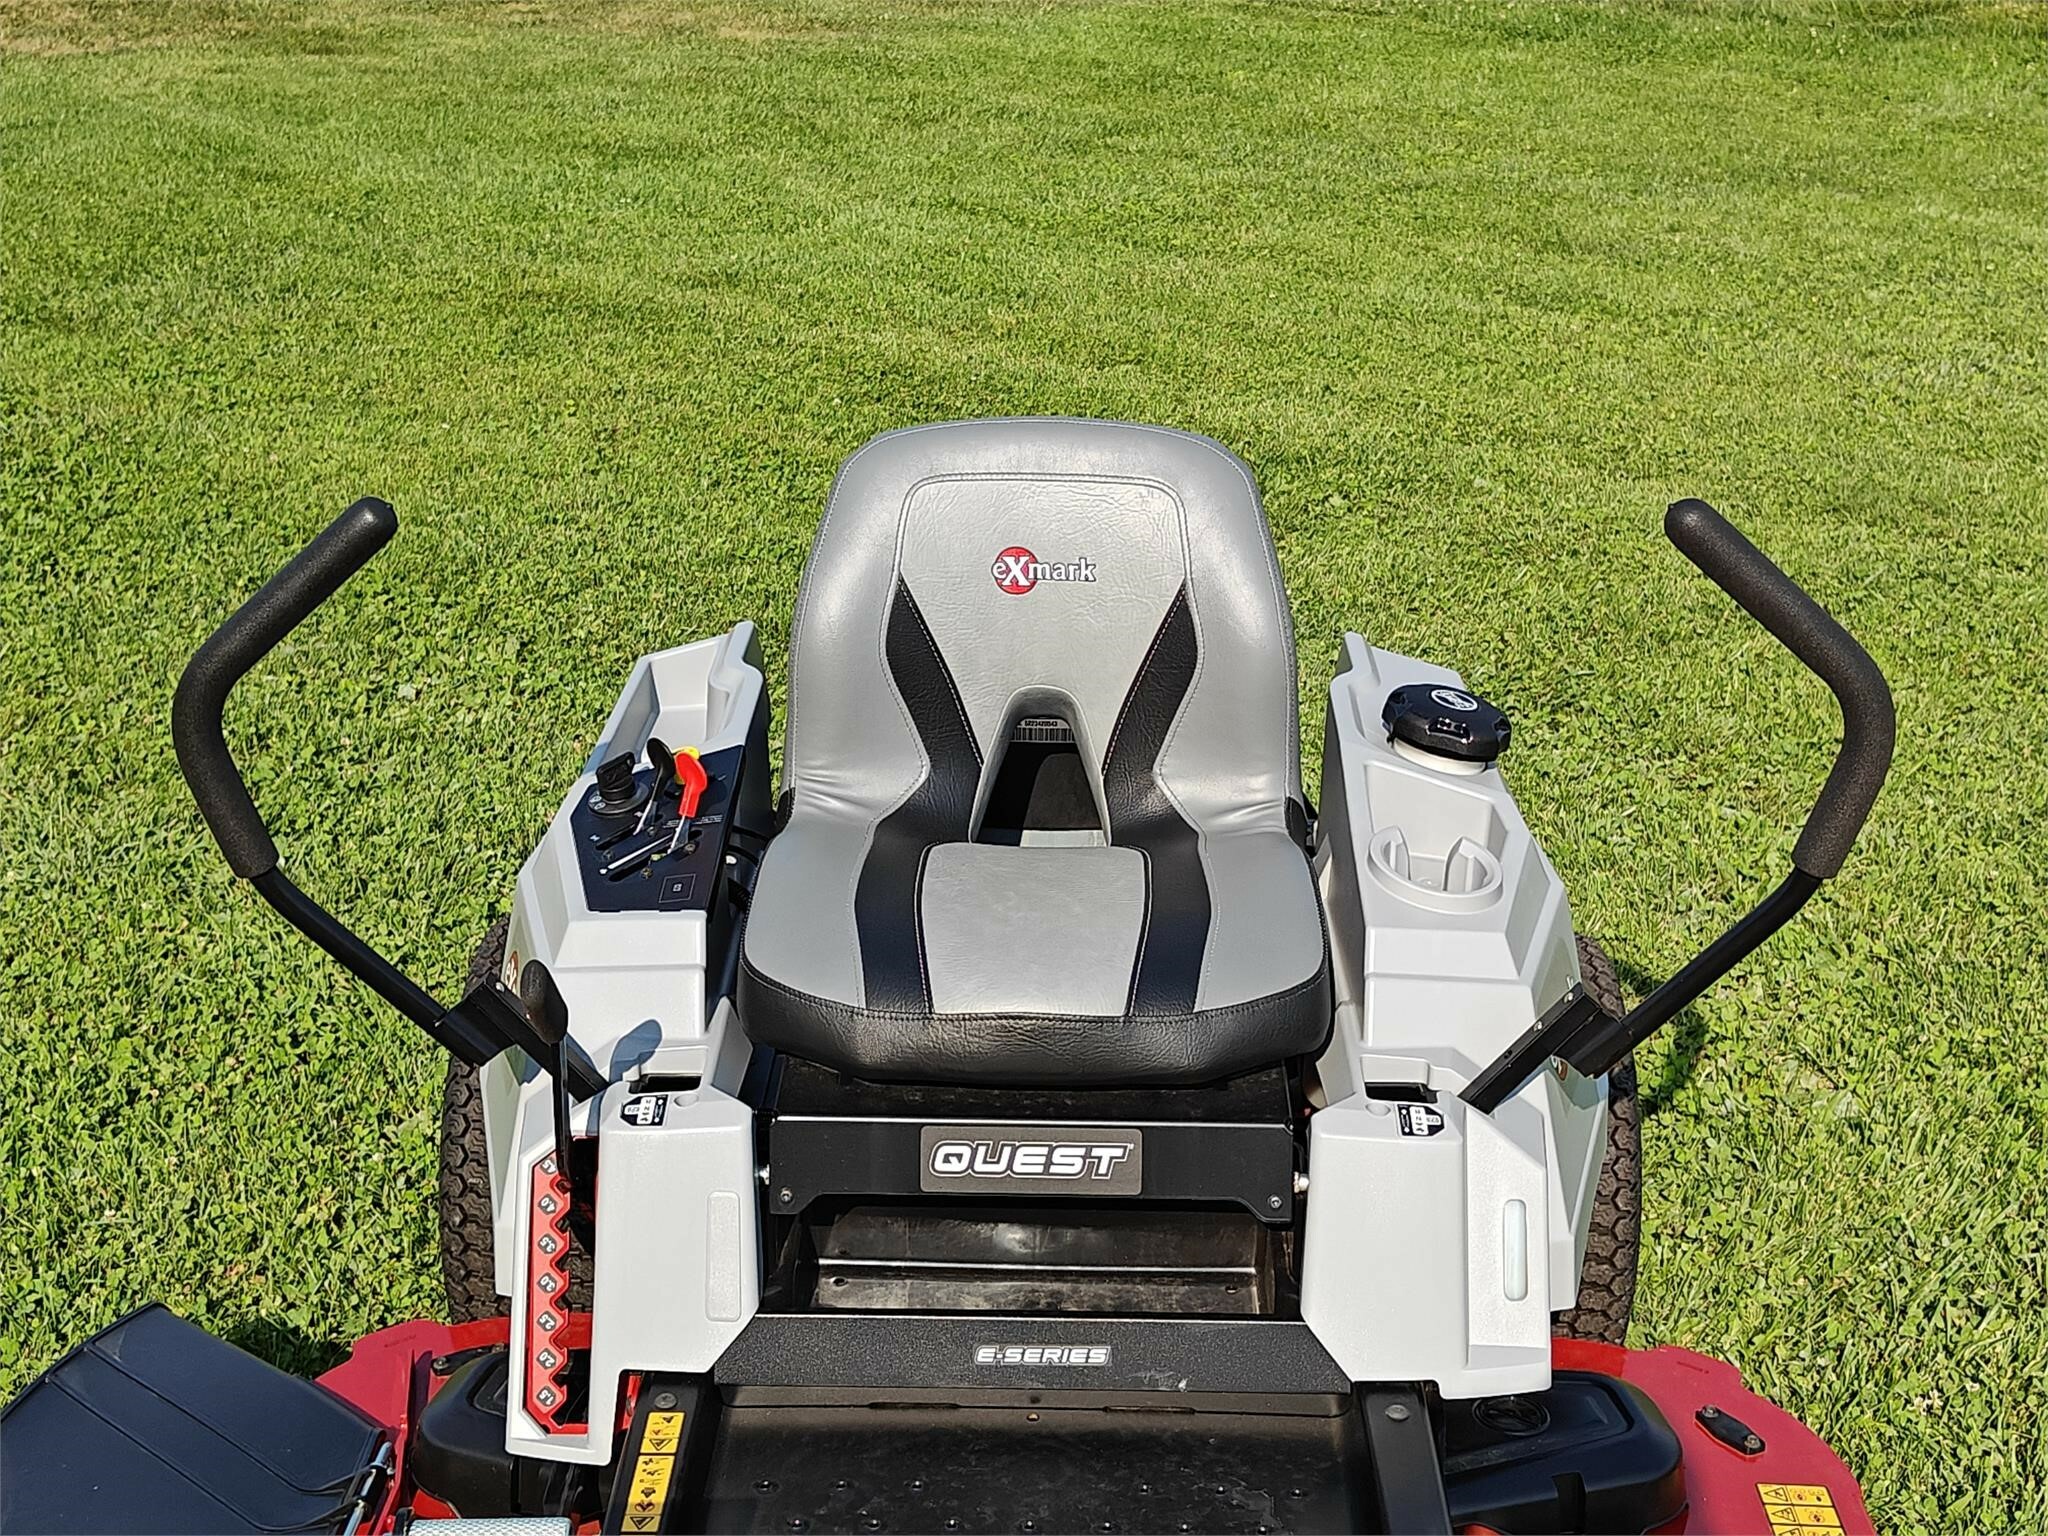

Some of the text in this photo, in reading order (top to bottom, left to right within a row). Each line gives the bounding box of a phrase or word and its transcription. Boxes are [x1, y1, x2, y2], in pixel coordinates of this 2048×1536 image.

[991, 554, 1097, 588] eXmark
[930, 1140, 1130, 1179] QUEST
[540, 1197, 556, 1212] 4.0
[539, 1237, 556, 1253] 3.5
[539, 1276, 556, 1292] 3.0
[538, 1314, 556, 1330] 2.5
[539, 1351, 556, 1367] 2.0
[975, 1346, 1110, 1365] E-SERIES
[538, 1389, 554, 1405] 1.5
